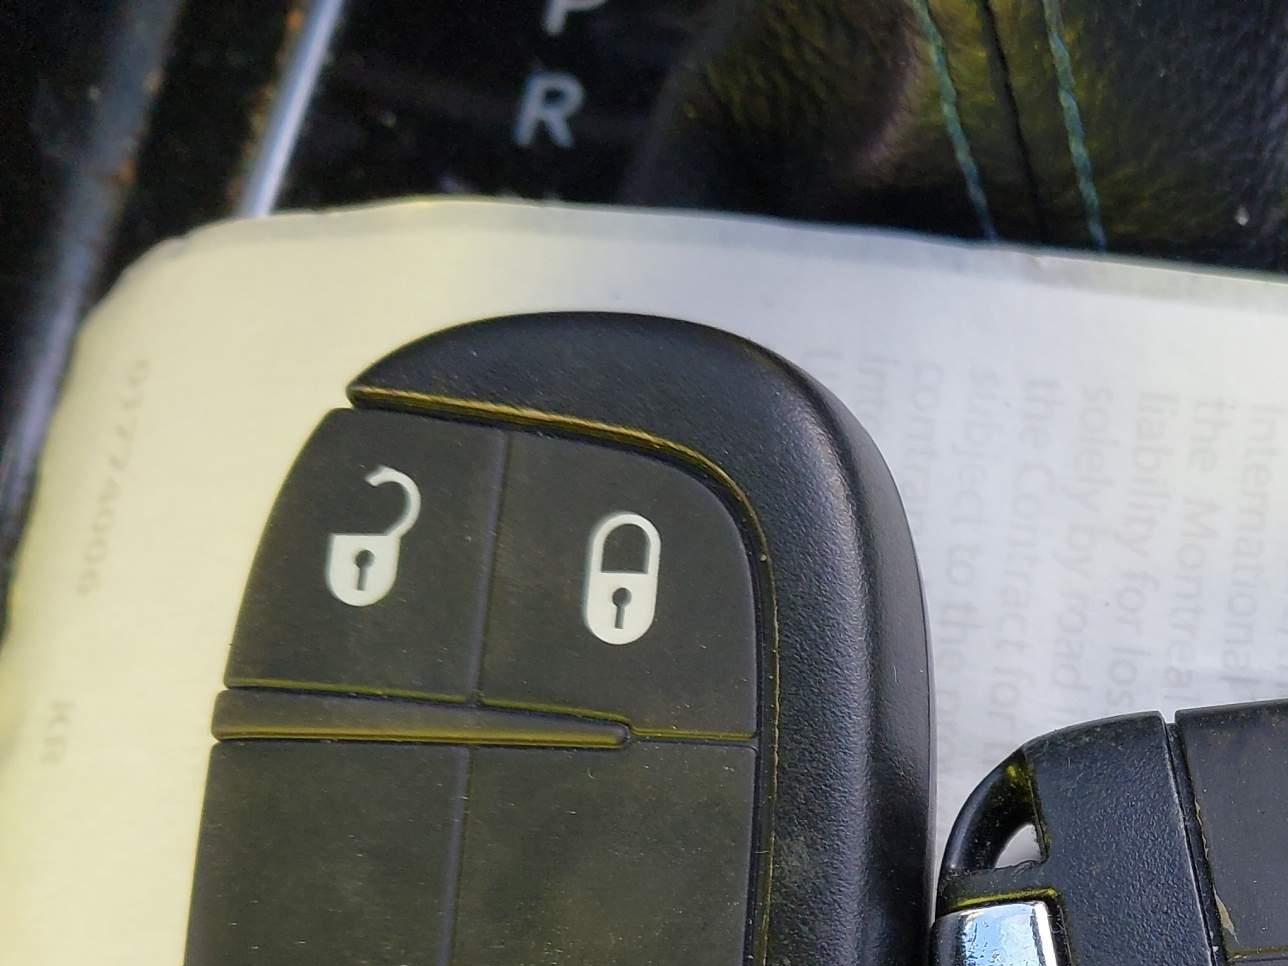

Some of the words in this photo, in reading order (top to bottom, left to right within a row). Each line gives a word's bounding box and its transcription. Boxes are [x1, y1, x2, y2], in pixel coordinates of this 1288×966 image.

[514, 71, 586, 148] R
[1017, 377, 1065, 450] the
[1060, 384, 1120, 514] solely
[1185, 398, 1229, 474] the
[1114, 390, 1180, 559] liability
[945, 544, 982, 588] to
[992, 463, 1058, 654] Contract
[935, 602, 982, 673] the
[1114, 568, 1160, 636] for
[1162, 497, 1222, 704] Montreal
[987, 666, 1037, 733] for
